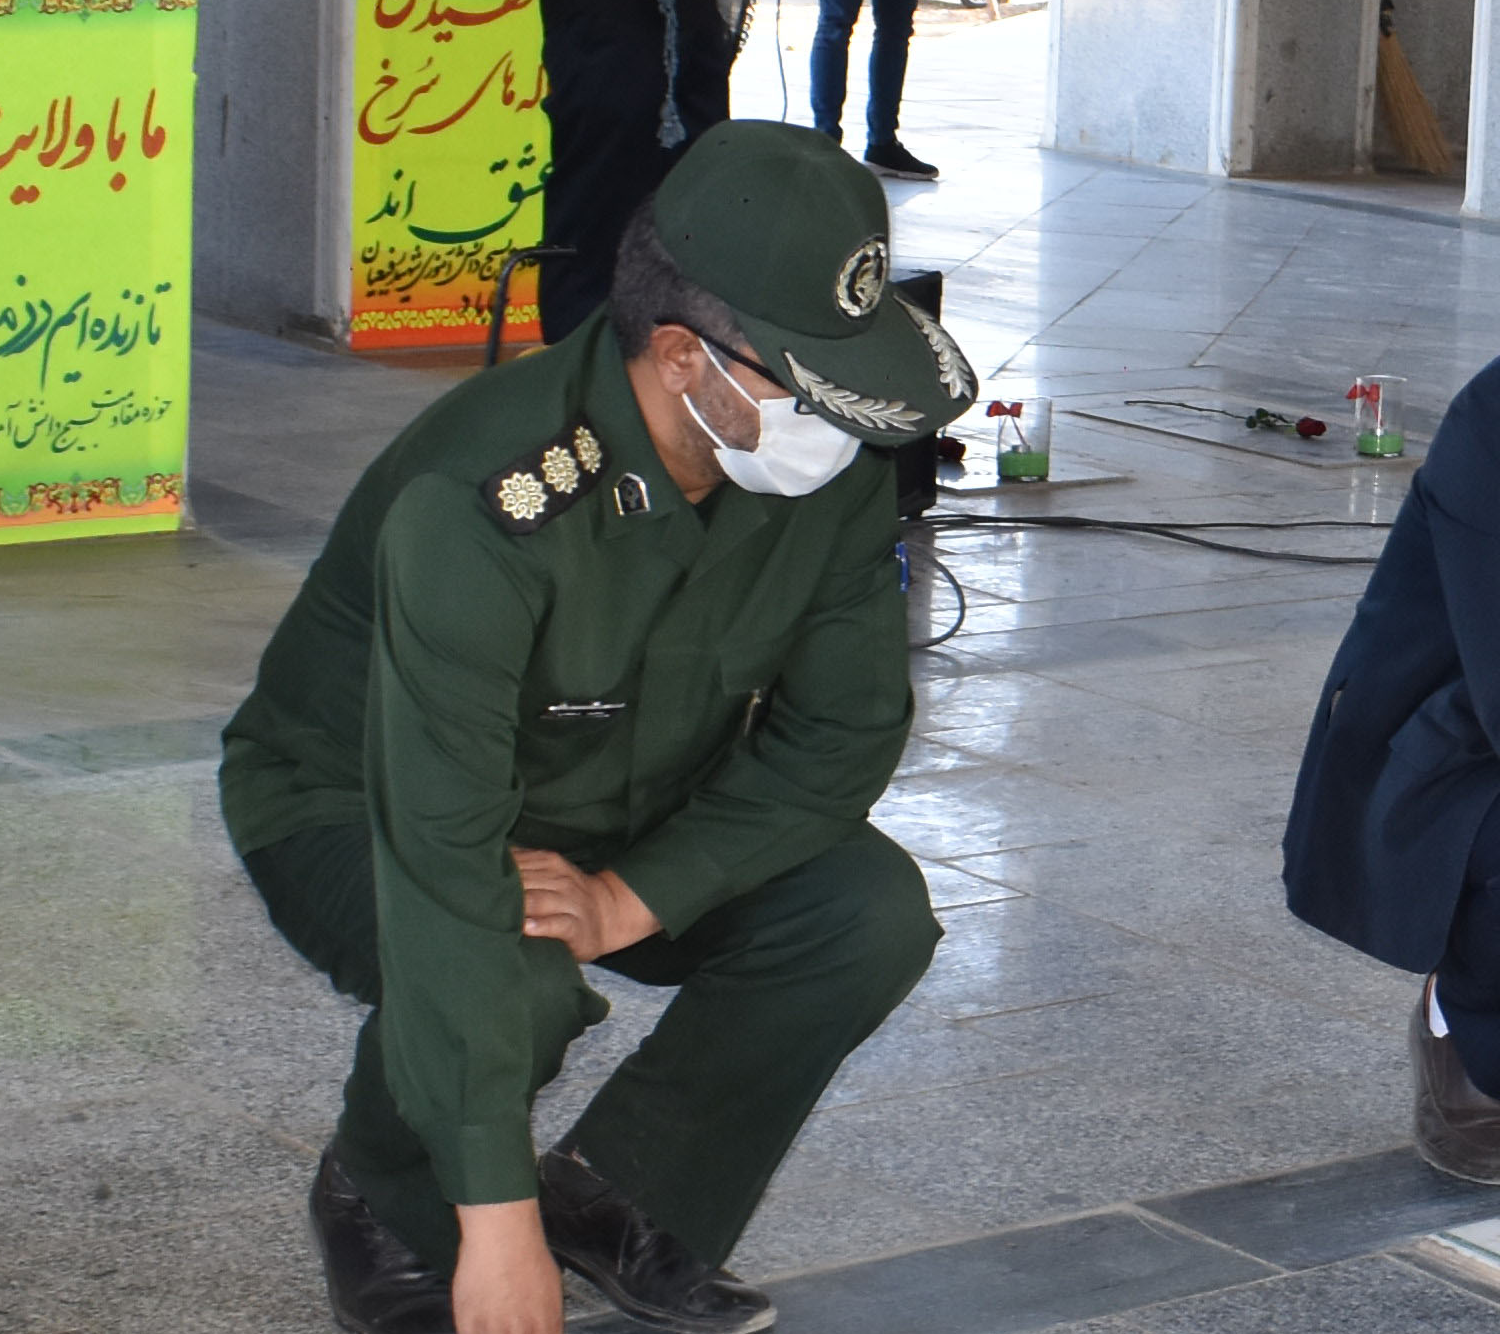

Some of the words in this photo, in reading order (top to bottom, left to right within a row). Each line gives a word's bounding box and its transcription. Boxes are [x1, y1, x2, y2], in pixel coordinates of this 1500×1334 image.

[107, 96, 127, 193] با
[141, 87, 166, 160] ما
[365, 168, 417, 224] اند
[39, 291, 92, 393] ایم
[88, 287, 146, 356] زنده
[147, 280, 172, 346] تا
[12, 397, 61, 450] دانش
[52, 409, 103, 455] بسیج
[90, 388, 142, 430] مقاومت
[141, 395, 173, 424] حوزه
